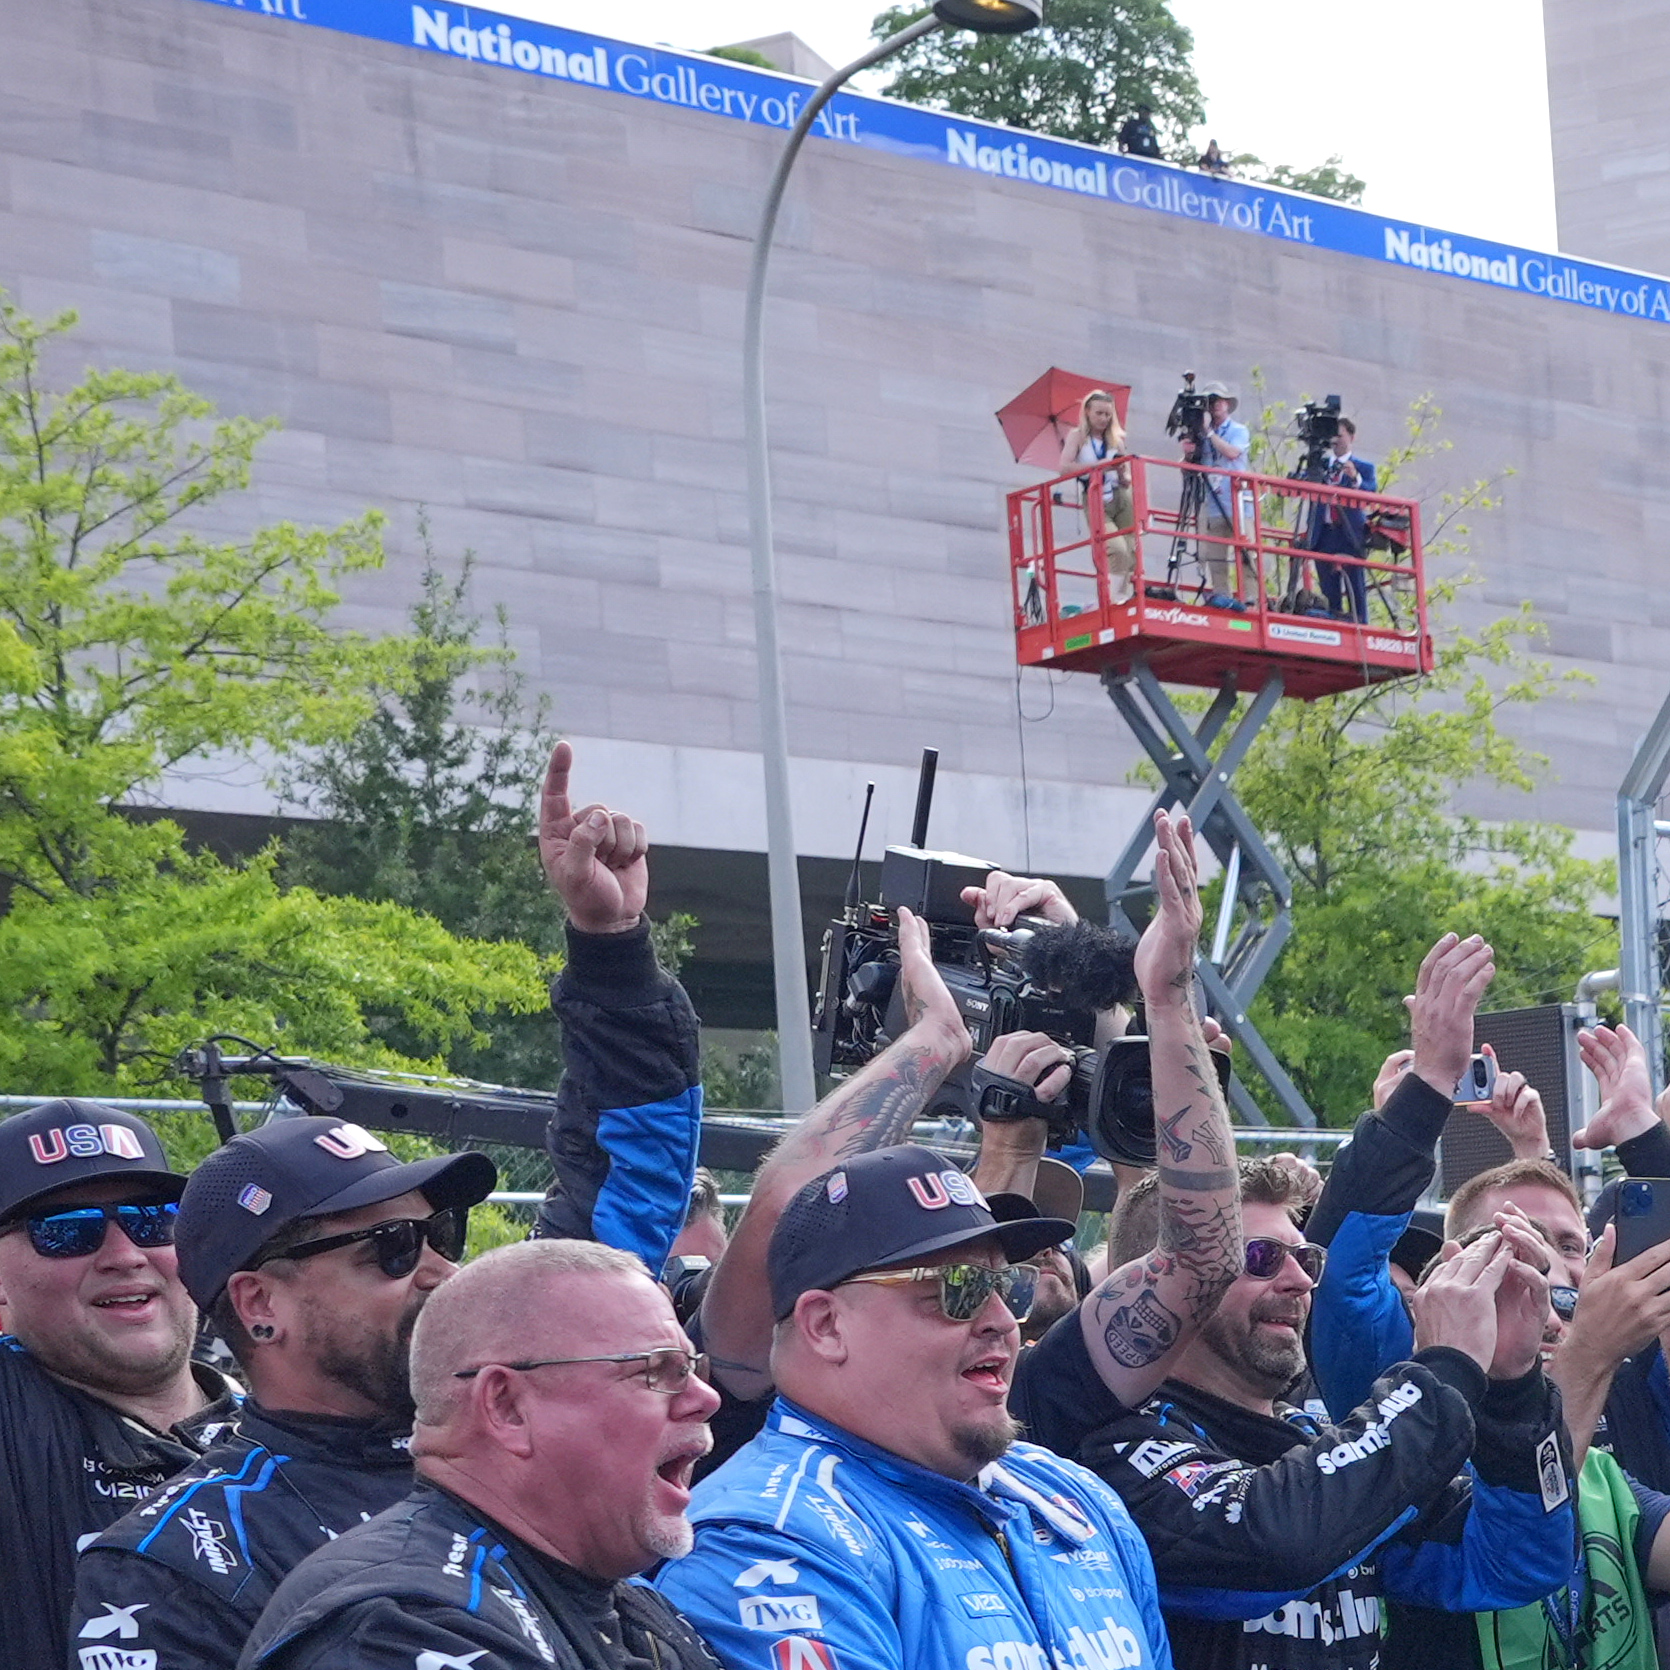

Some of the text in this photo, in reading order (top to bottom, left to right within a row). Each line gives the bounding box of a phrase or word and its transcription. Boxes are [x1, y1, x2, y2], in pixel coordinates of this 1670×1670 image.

[411, 4, 611, 87] National
[614, 52, 758, 123] Gallery
[761, 92, 799, 128] of
[946, 127, 1315, 243] National Gallery of Art
[1383, 227, 1519, 288] National
[1521, 258, 1621, 312] Gallery
[1621, 288, 1648, 315] of
[965, 998, 989, 1012] SONY
[746, 1602, 814, 1630] TWG
